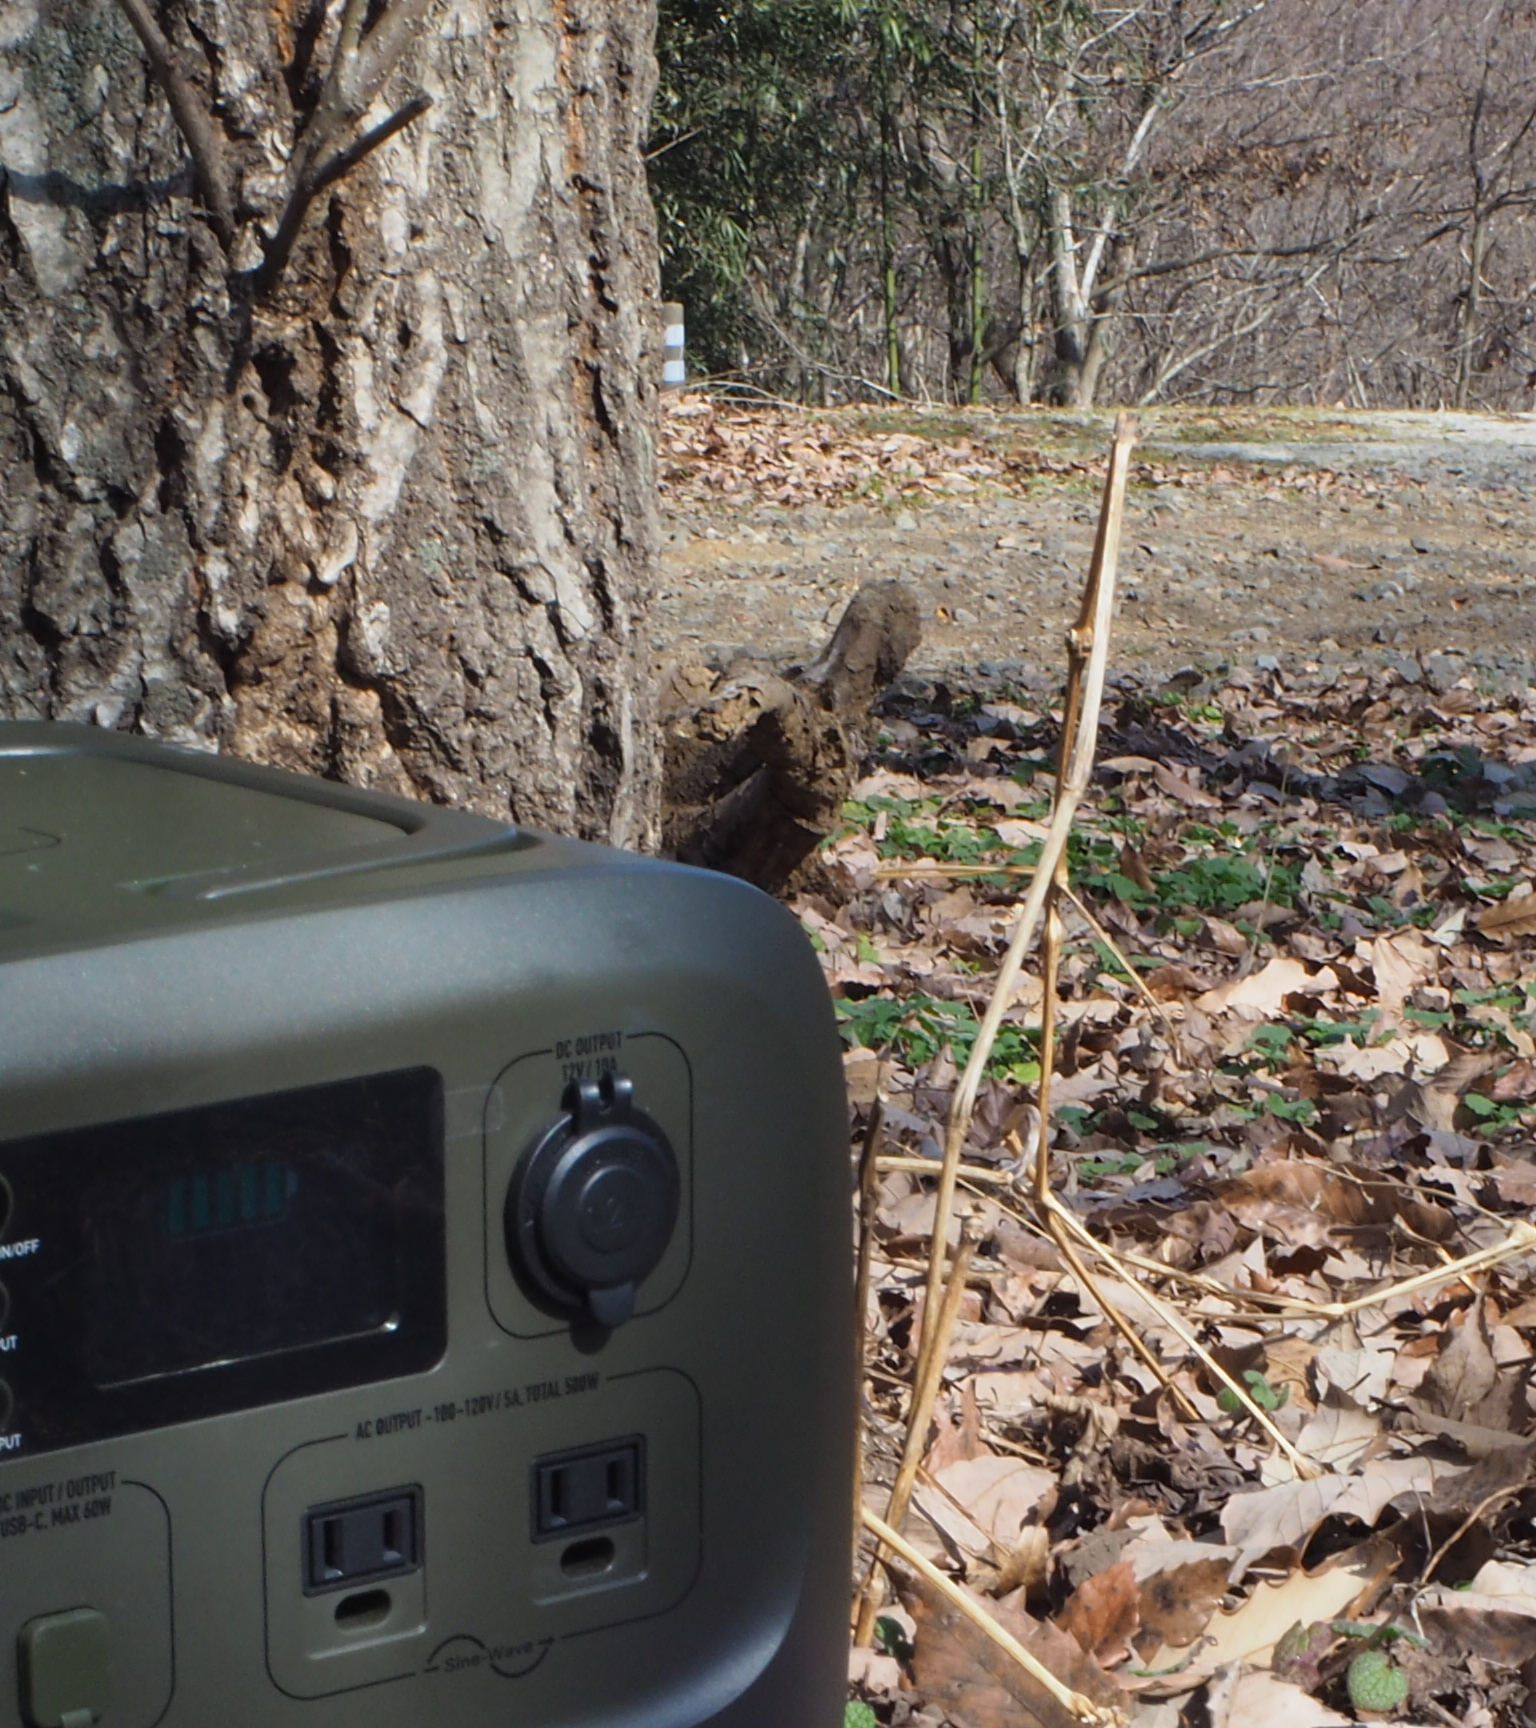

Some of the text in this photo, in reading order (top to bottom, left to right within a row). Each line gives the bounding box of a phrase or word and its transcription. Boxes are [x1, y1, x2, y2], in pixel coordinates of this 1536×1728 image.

[555, 1031, 622, 1060] DC OUTPUT
[356, 1421, 373, 1440] AC
[375, 1408, 423, 1436] OUTPUT
[66, 1470, 117, 1499] OUTPUT
[51, 1502, 81, 1527] MAX
[443, 1640, 534, 1673] Sine-Wave
